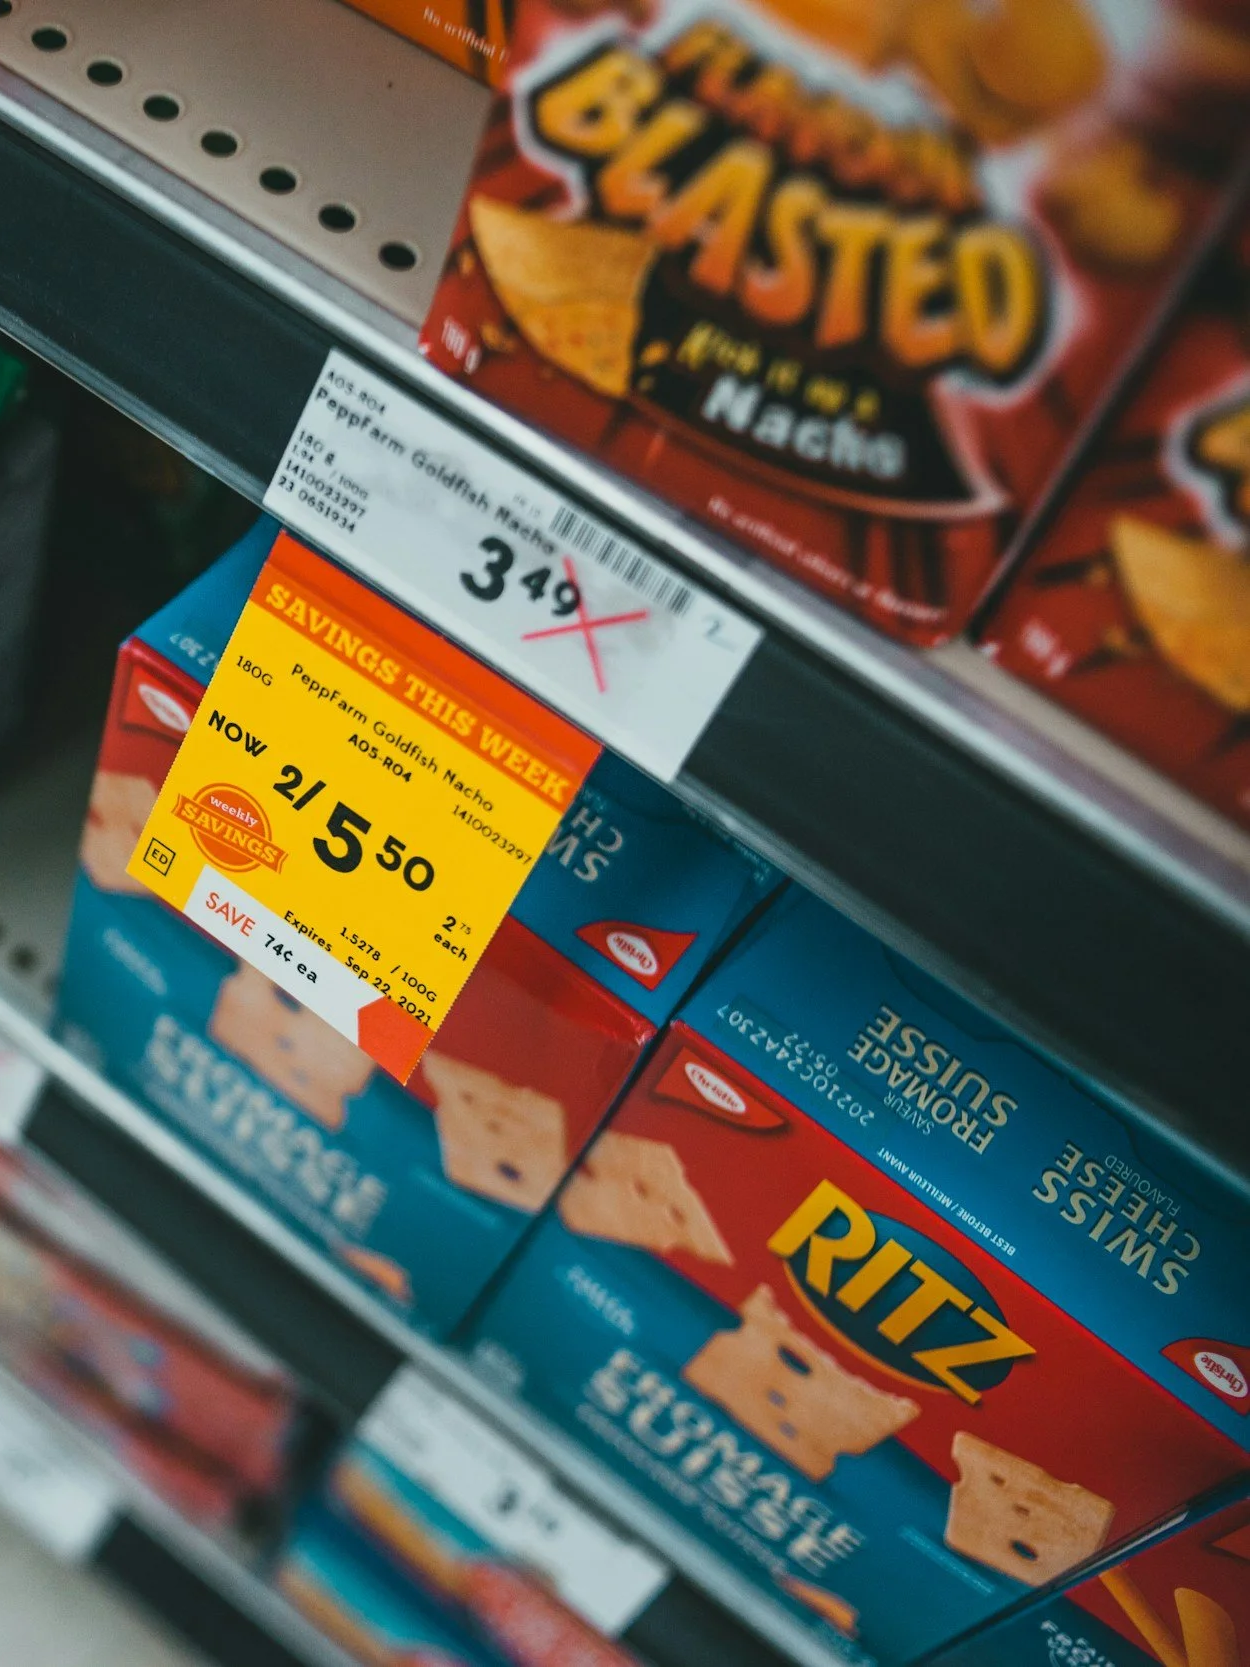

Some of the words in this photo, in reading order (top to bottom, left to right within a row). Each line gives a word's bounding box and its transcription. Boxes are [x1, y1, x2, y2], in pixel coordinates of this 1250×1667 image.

[537, 45, 1037, 371] BLASTED
[701, 372, 908, 479] Nacho
[285, 458, 366, 520] 1410023297
[315, 386, 406, 457] PeppFarm
[411, 448, 490, 514] Goldfish
[493, 502, 557, 555] Nacho
[298, 489, 356, 533] 0651934
[236, 655, 273, 687] 180G
[265, 583, 400, 686] SAVINGS
[403, 675, 478, 738] THIS
[479, 725, 572, 803] WEEK
[208, 709, 268, 757] NOW
[291, 663, 369, 724] PeppFarm
[373, 721, 439, 775] Goldfish
[443, 768, 494, 812] Nacho
[348, 733, 413, 783] A05-R04
[181, 803, 278, 864] SAVINGS
[210, 795, 258, 828] weekly
[452, 804, 532, 866] 1410023297
[151, 847, 168, 865] ED
[206, 892, 256, 937] SAVE
[264, 932, 293, 963] 74¢
[296, 961, 318, 984] ea
[284, 910, 332, 952] Expires
[345, 956, 369, 981] Sep
[398, 994, 431, 1027] 2021
[341, 926, 381, 962] 1.5278
[434, 931, 468, 962] each
[847, 1033, 995, 1155] FROMAGE
[867, 1005, 1019, 1128] SUISSE
[883, 1091, 935, 1136] SAVEUR
[877, 1148, 908, 1175] AVANT
[907, 1168, 952, 1209] MEILLEUR
[1105, 1154, 1181, 1217] FLAVOURED
[956, 1203, 993, 1239] BEFORE
[1032, 1170, 1190, 1295] SWISS
[1055, 1142, 1201, 1261] CHEESE
[990, 1232, 1016, 1256] BEST
[766, 1178, 1036, 1405] RITZ
[1201, 1354, 1243, 1394] Christie
[591, 1367, 837, 1577] SUISSE
[608, 1349, 866, 1558] FROMAGE
